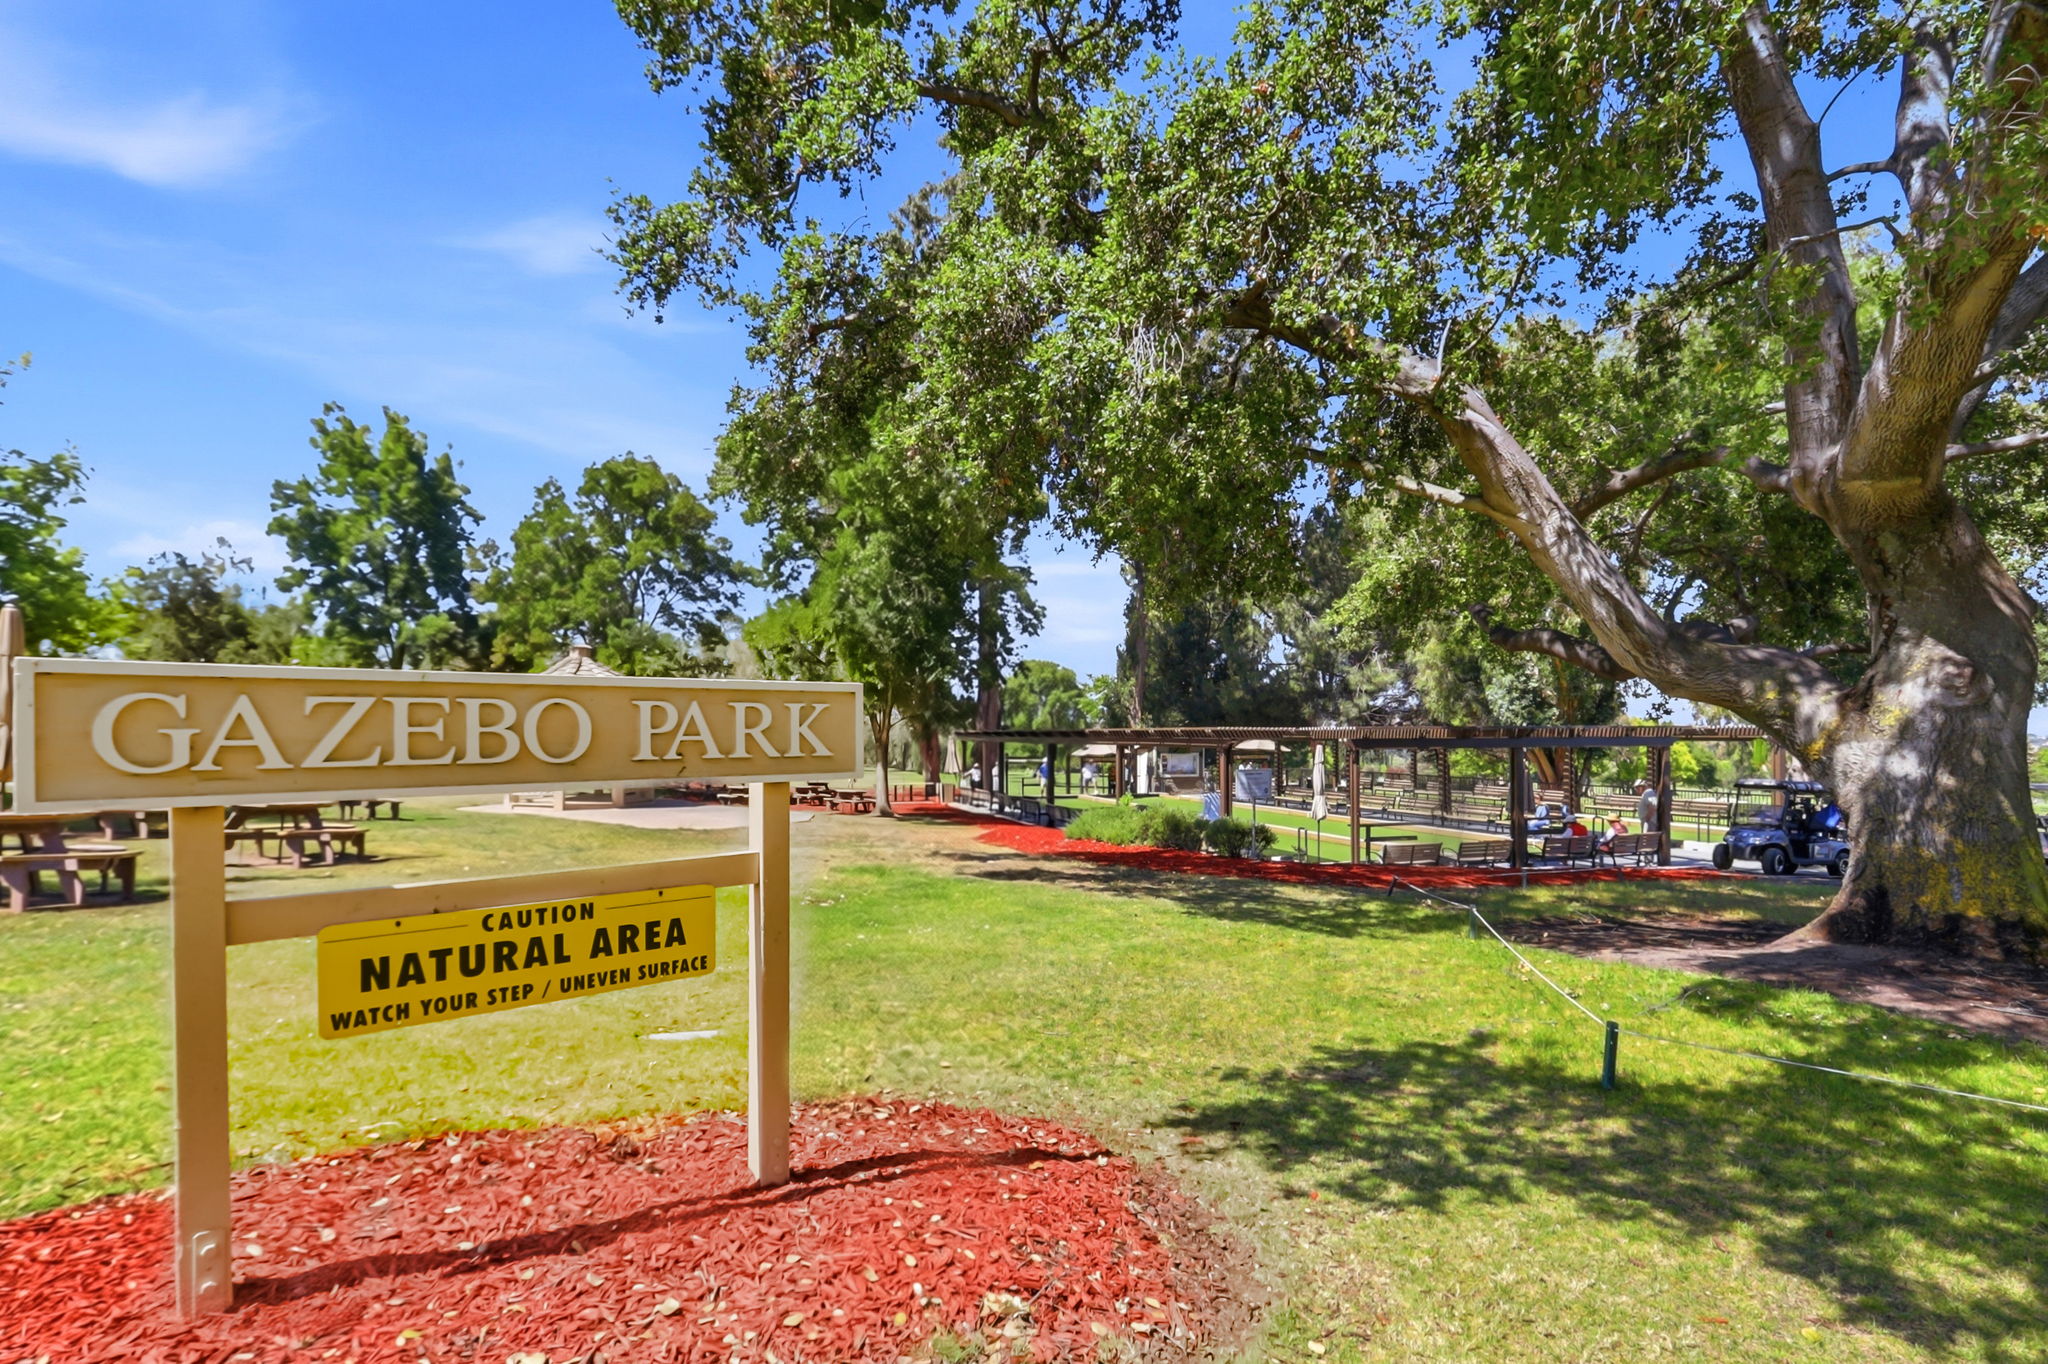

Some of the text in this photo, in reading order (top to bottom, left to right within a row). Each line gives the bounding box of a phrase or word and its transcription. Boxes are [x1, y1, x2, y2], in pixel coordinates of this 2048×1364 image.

[91, 691, 835, 775] GAZEBO PARK
[359, 917, 687, 993] NATURAL AREA
[481, 902, 595, 932] CAUTION
[330, 955, 708, 1031] WATCH YOUR STEP / UNEVEN SURFACE
